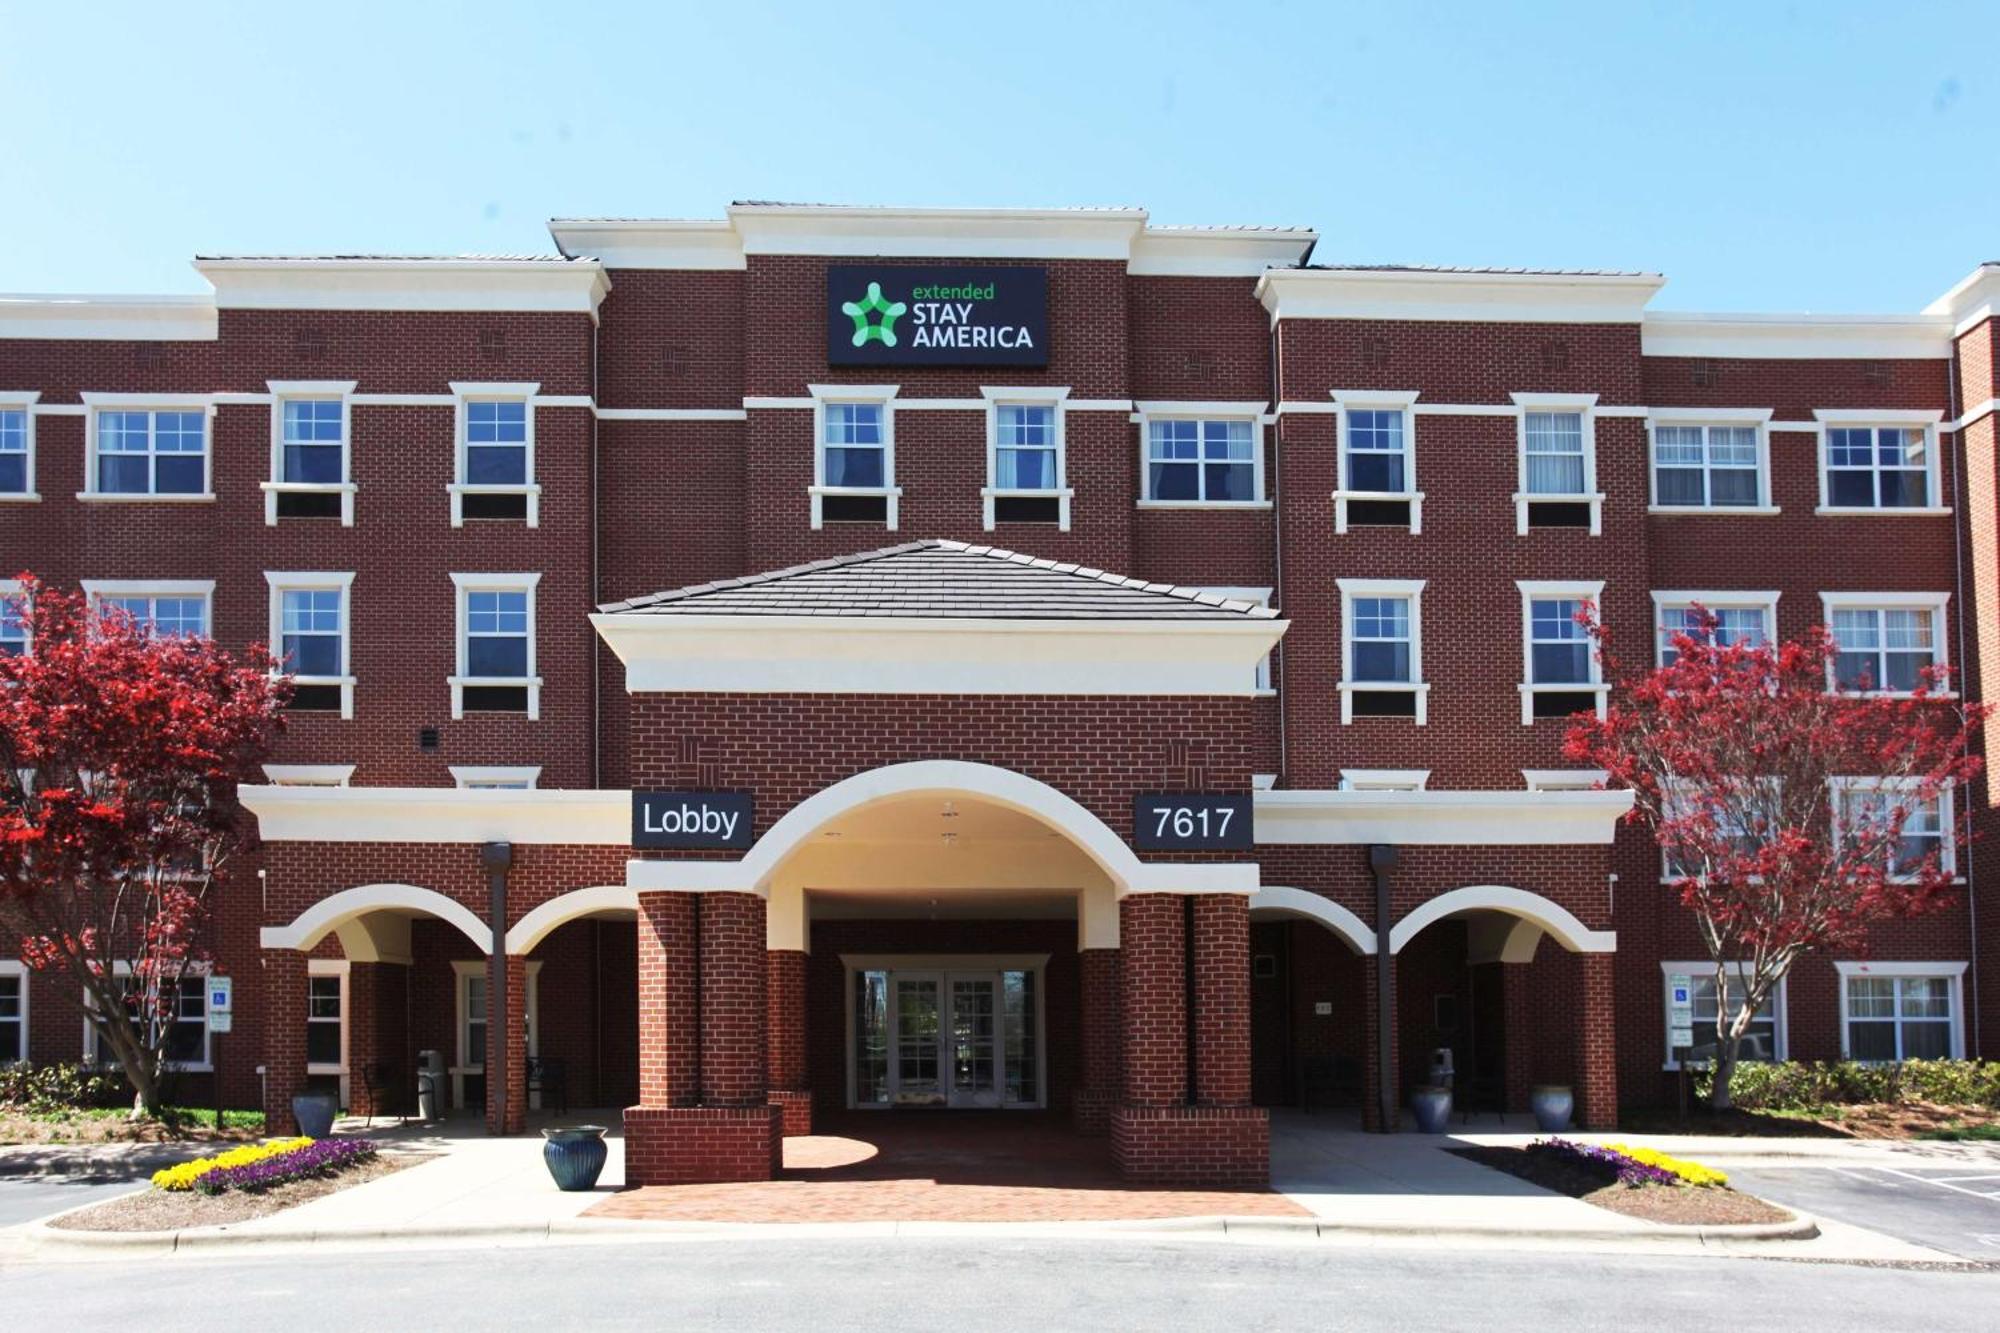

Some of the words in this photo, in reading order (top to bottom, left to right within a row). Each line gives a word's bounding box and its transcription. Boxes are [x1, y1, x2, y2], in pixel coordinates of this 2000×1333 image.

[912, 282, 993, 300] extended
[912, 302, 973, 325] STAY
[912, 326, 1034, 348] AMERICA
[643, 803, 739, 840] Lobby
[1152, 807, 1235, 837] 7617
